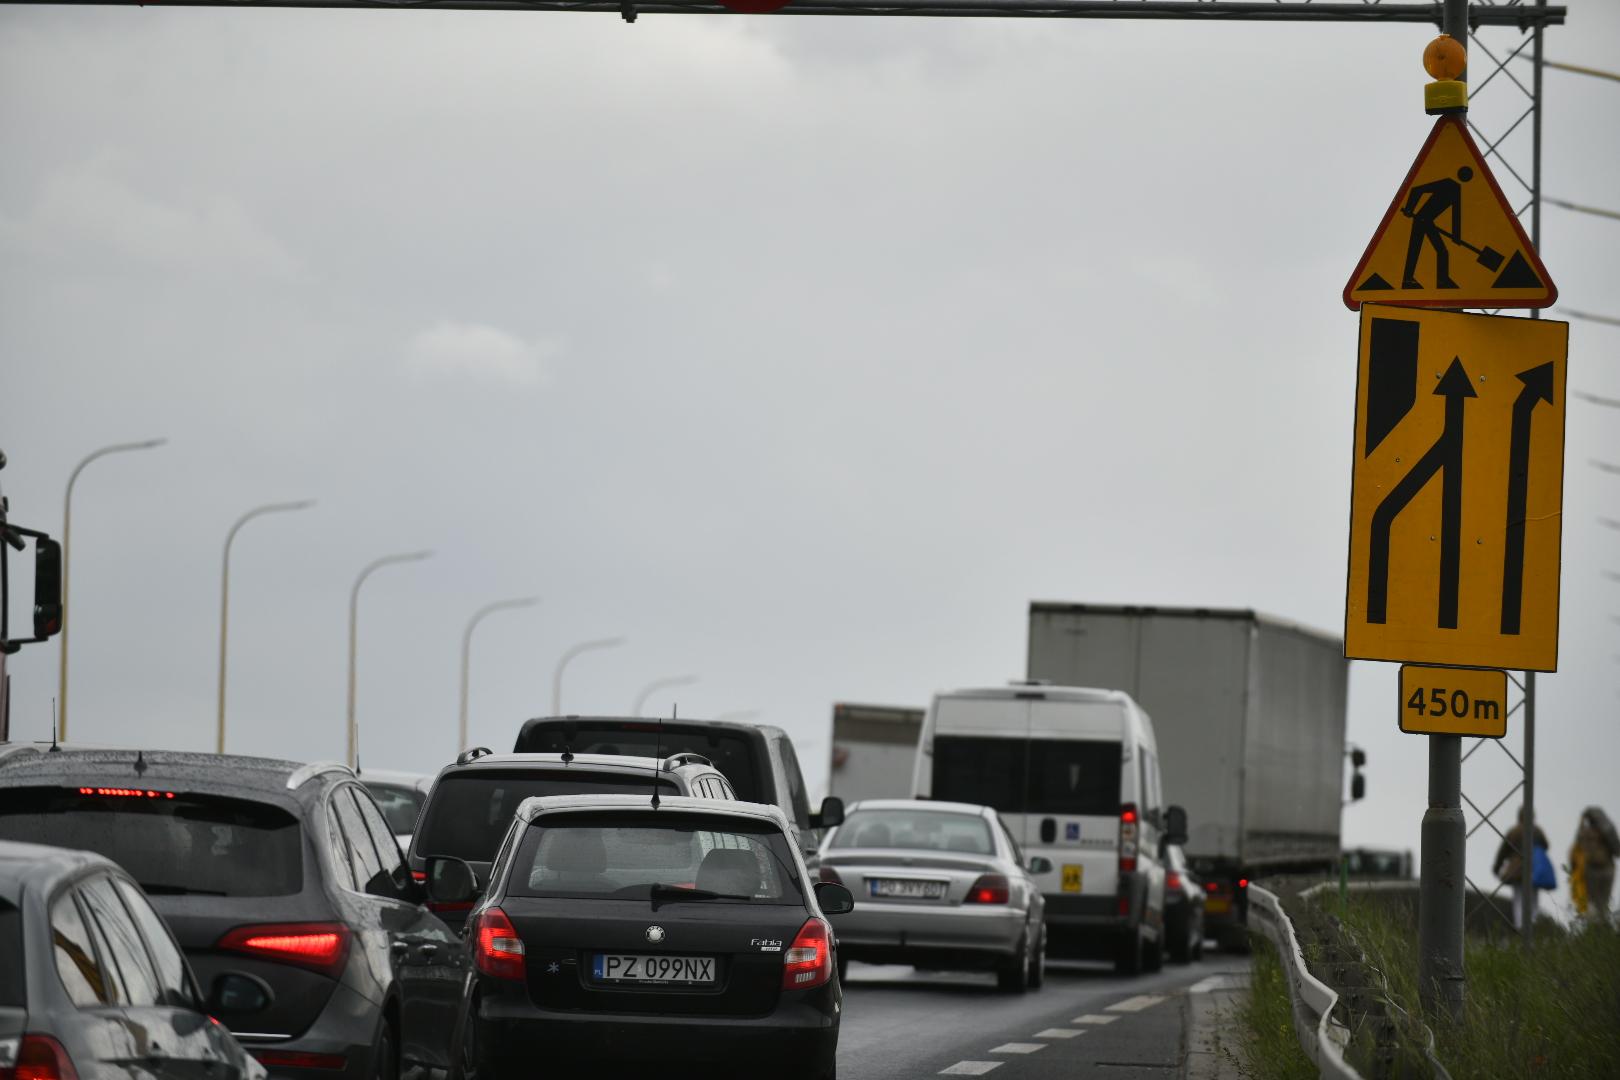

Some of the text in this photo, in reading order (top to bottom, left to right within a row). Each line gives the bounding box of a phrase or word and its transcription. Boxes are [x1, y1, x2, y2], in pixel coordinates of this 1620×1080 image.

[1407, 687, 1499, 720] 450m
[750, 938, 782, 946] Fabia
[606, 956, 711, 980] PZ 099NX
